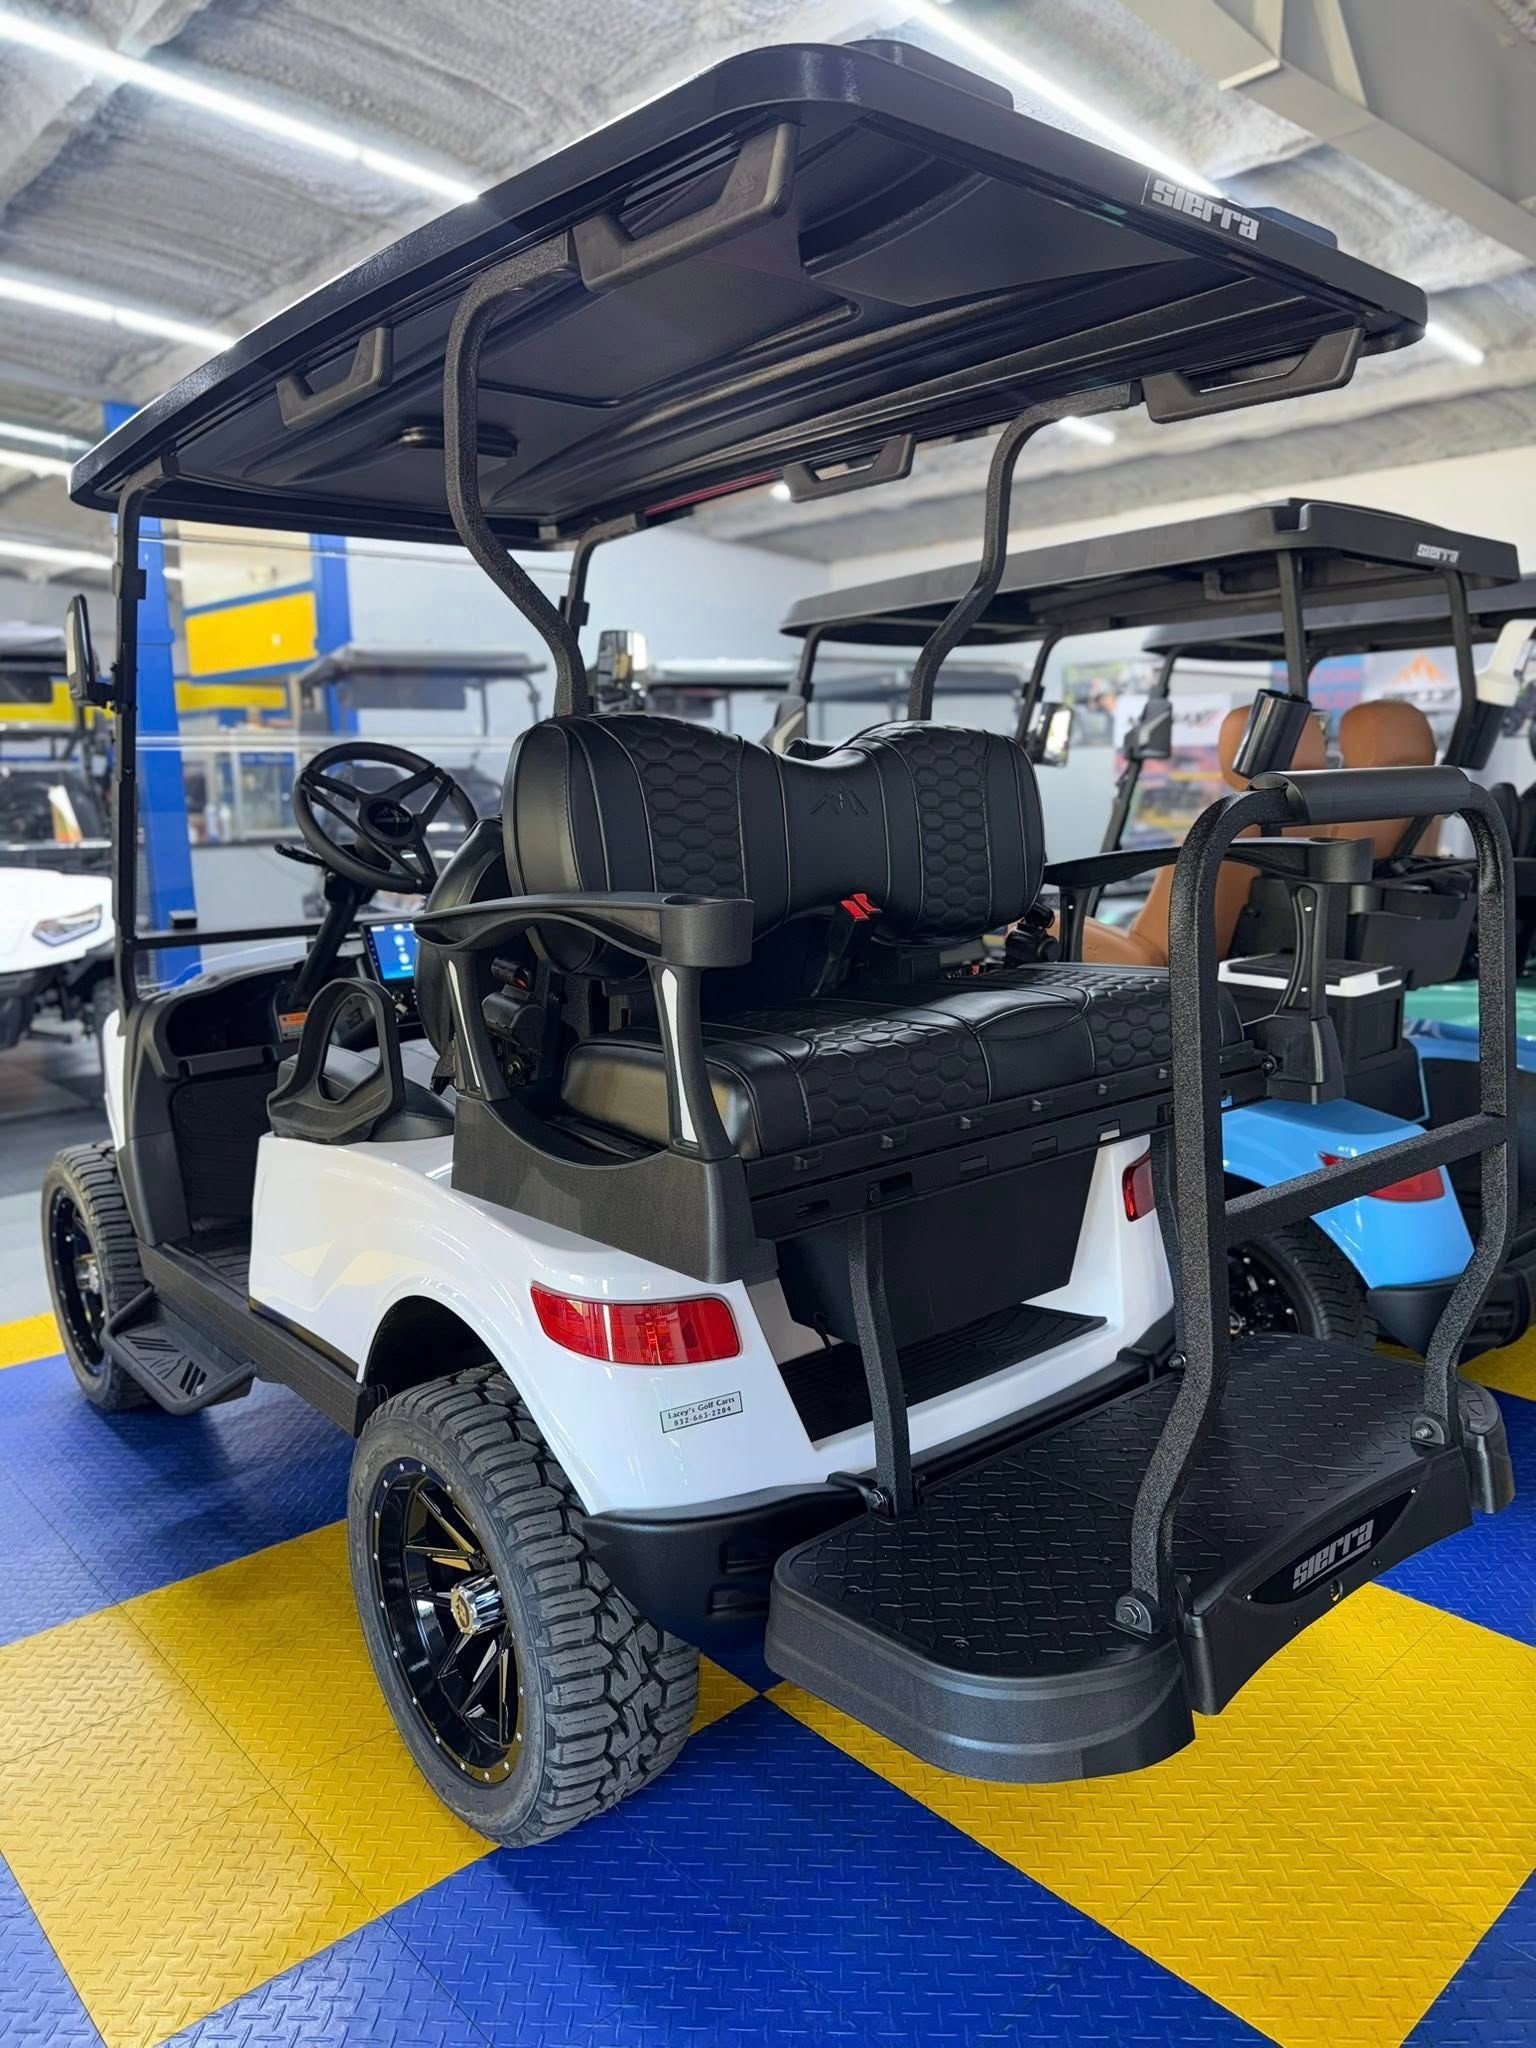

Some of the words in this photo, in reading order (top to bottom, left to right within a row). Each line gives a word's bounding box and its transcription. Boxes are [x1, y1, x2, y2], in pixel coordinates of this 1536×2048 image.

[1151, 178, 1259, 241] sierra
[668, 1406, 696, 1420] Lacey's
[697, 1401, 714, 1411] Golf
[715, 1396, 735, 1407] Carts
[1292, 1518, 1375, 1590] sierra
